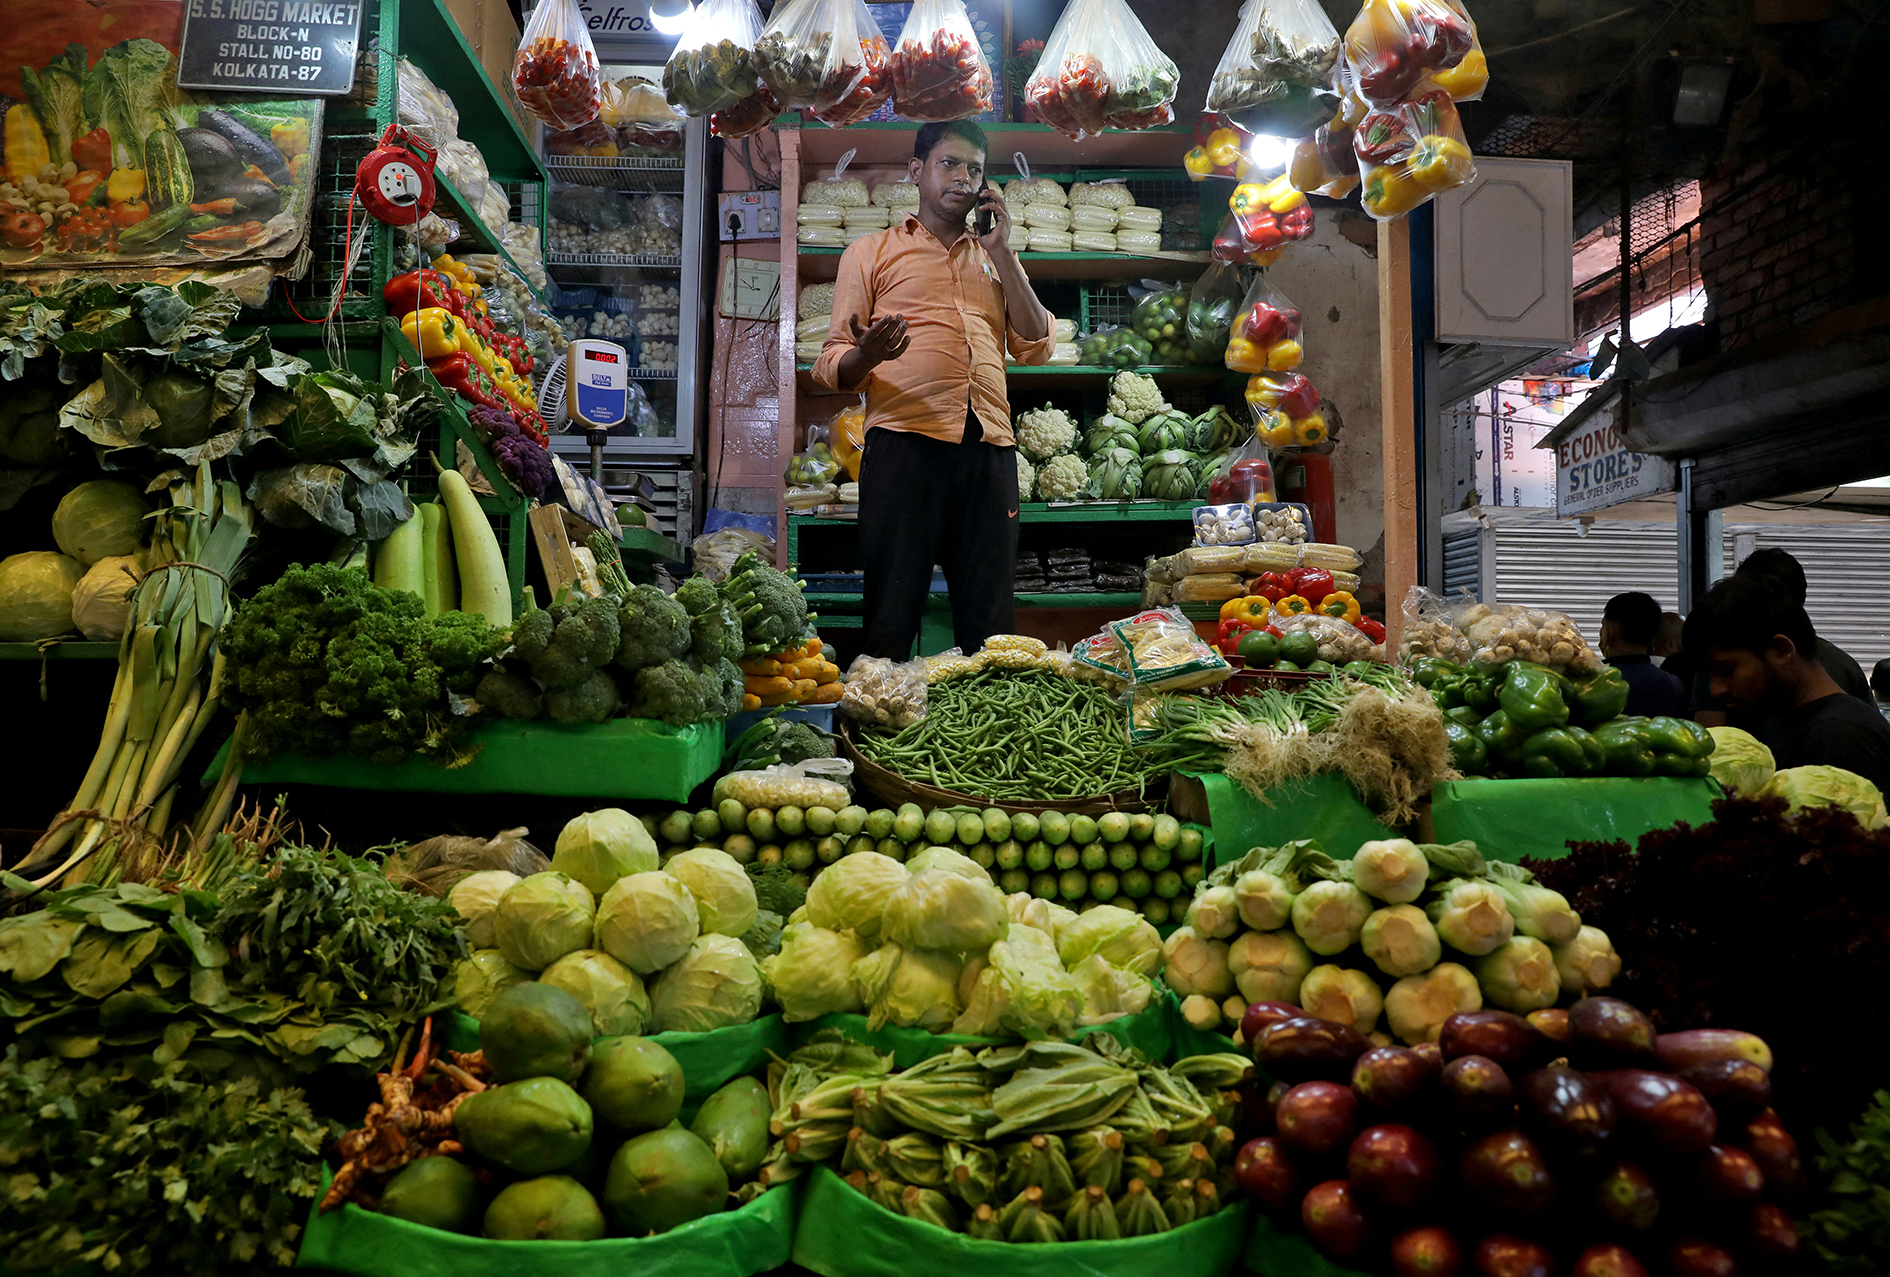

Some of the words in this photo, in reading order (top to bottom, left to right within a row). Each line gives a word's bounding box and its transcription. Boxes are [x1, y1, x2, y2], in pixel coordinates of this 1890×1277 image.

[229, 0, 279, 22] HOGG
[282, 1, 357, 26] MARKET
[237, 24, 309, 42] BLOCK-N
[218, 43, 269, 59] STALL
[272, 45, 322, 61] NO-80
[213, 63, 322, 81] KOLKATA-87
[1503, 401, 1517, 461] ALSTAR
[1560, 424, 1624, 470] ECONO
[1569, 450, 1643, 493] STORES
[1563, 490, 1586, 506] GENERAL
[1605, 475, 1639, 495] SUPPLIERS
